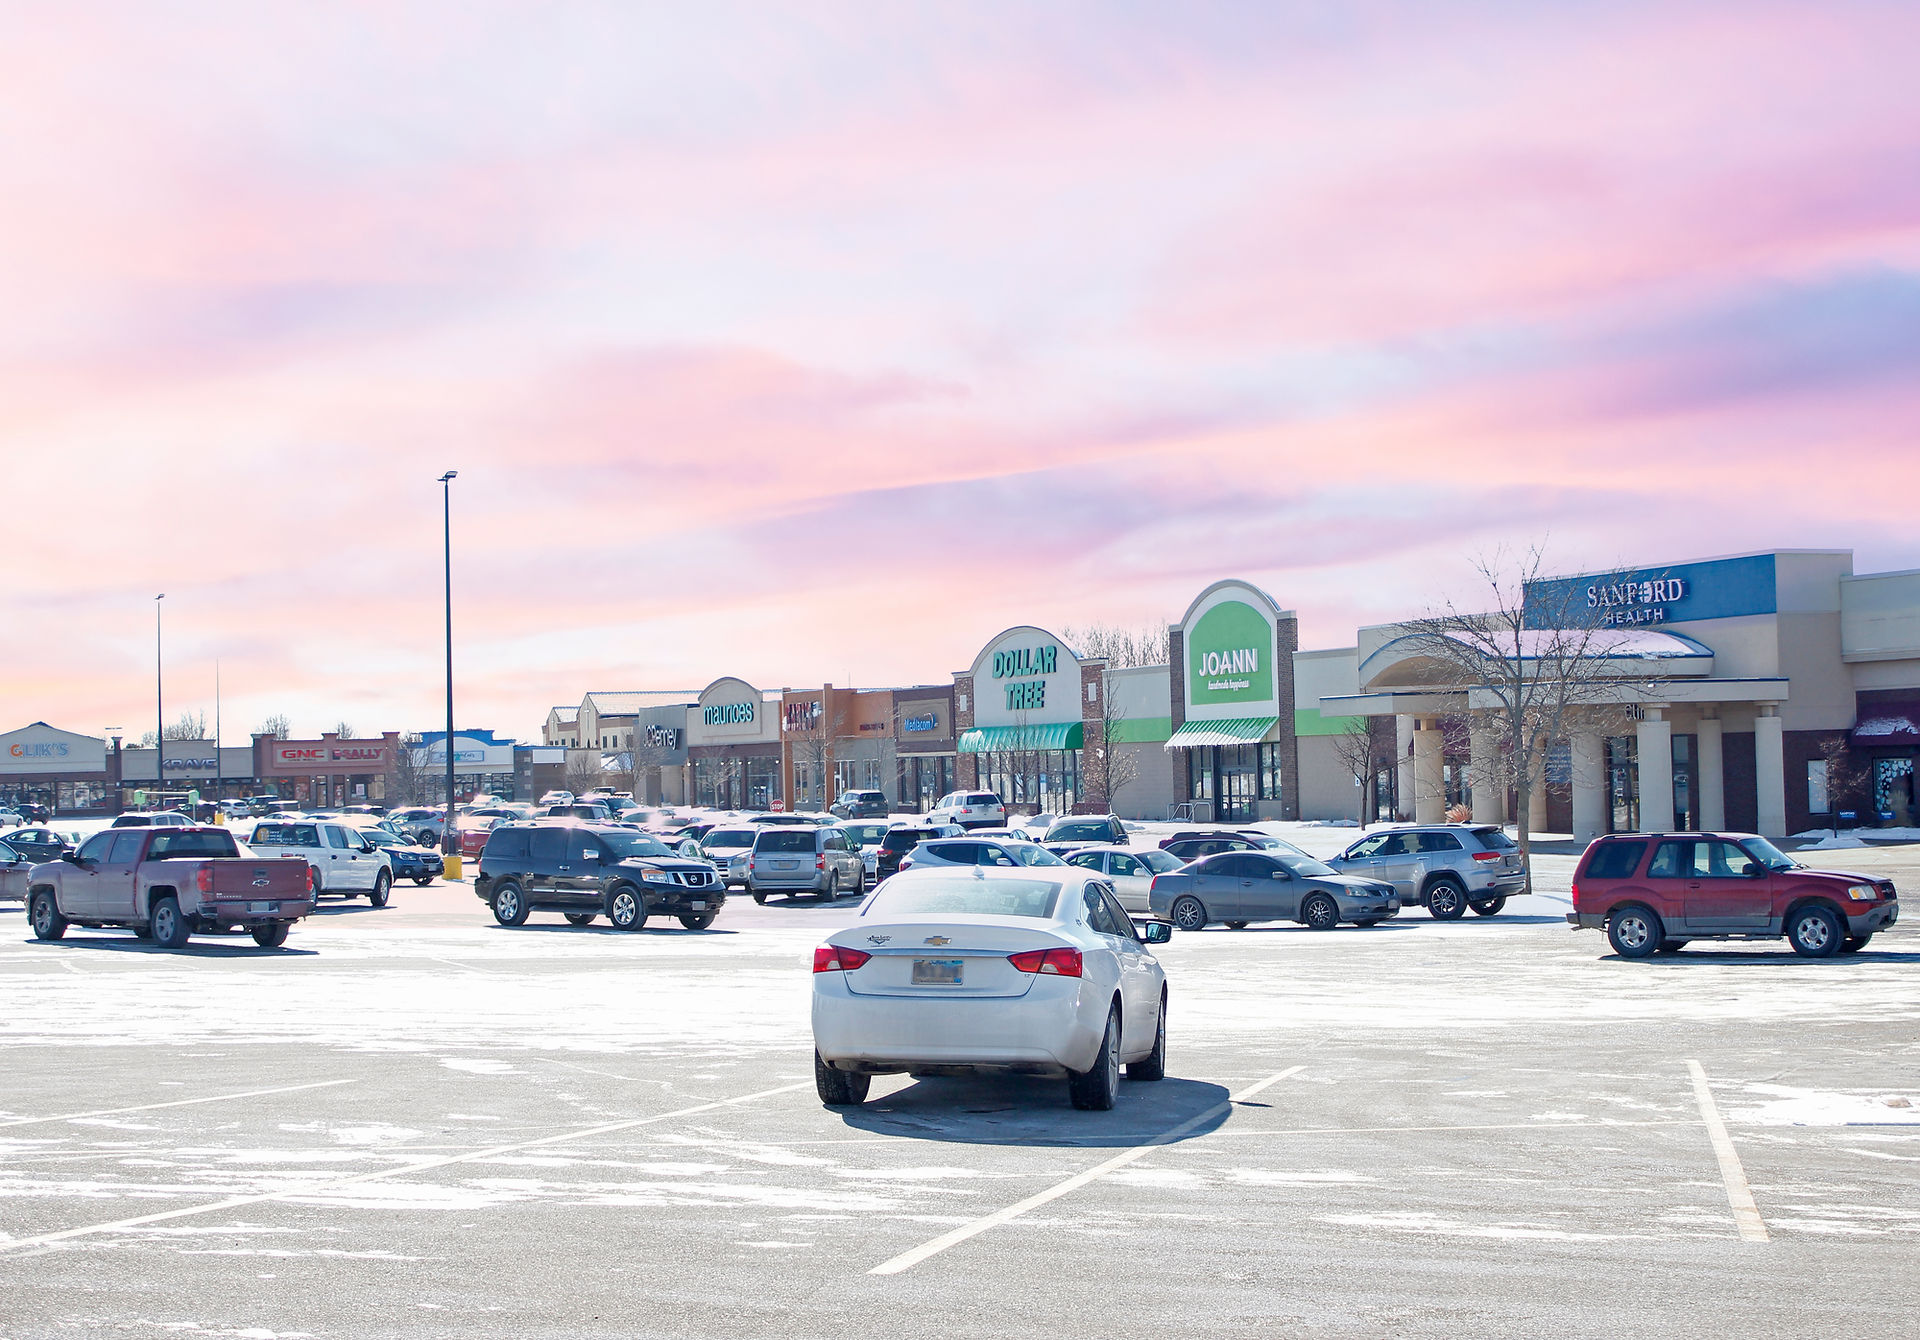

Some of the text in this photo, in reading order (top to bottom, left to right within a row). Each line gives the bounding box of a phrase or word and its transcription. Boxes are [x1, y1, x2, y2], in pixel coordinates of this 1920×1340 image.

[1606, 608, 1663, 624] HEALTH
[992, 645, 1057, 679] DOLLAR
[1199, 648, 1258, 677] JOANN
[1004, 681, 1046, 711] TREE
[704, 702, 754, 726] maurices
[161, 758, 217, 770] KRAVE
[281, 749, 325, 759] GNC
[342, 748, 383, 760] SALLY
